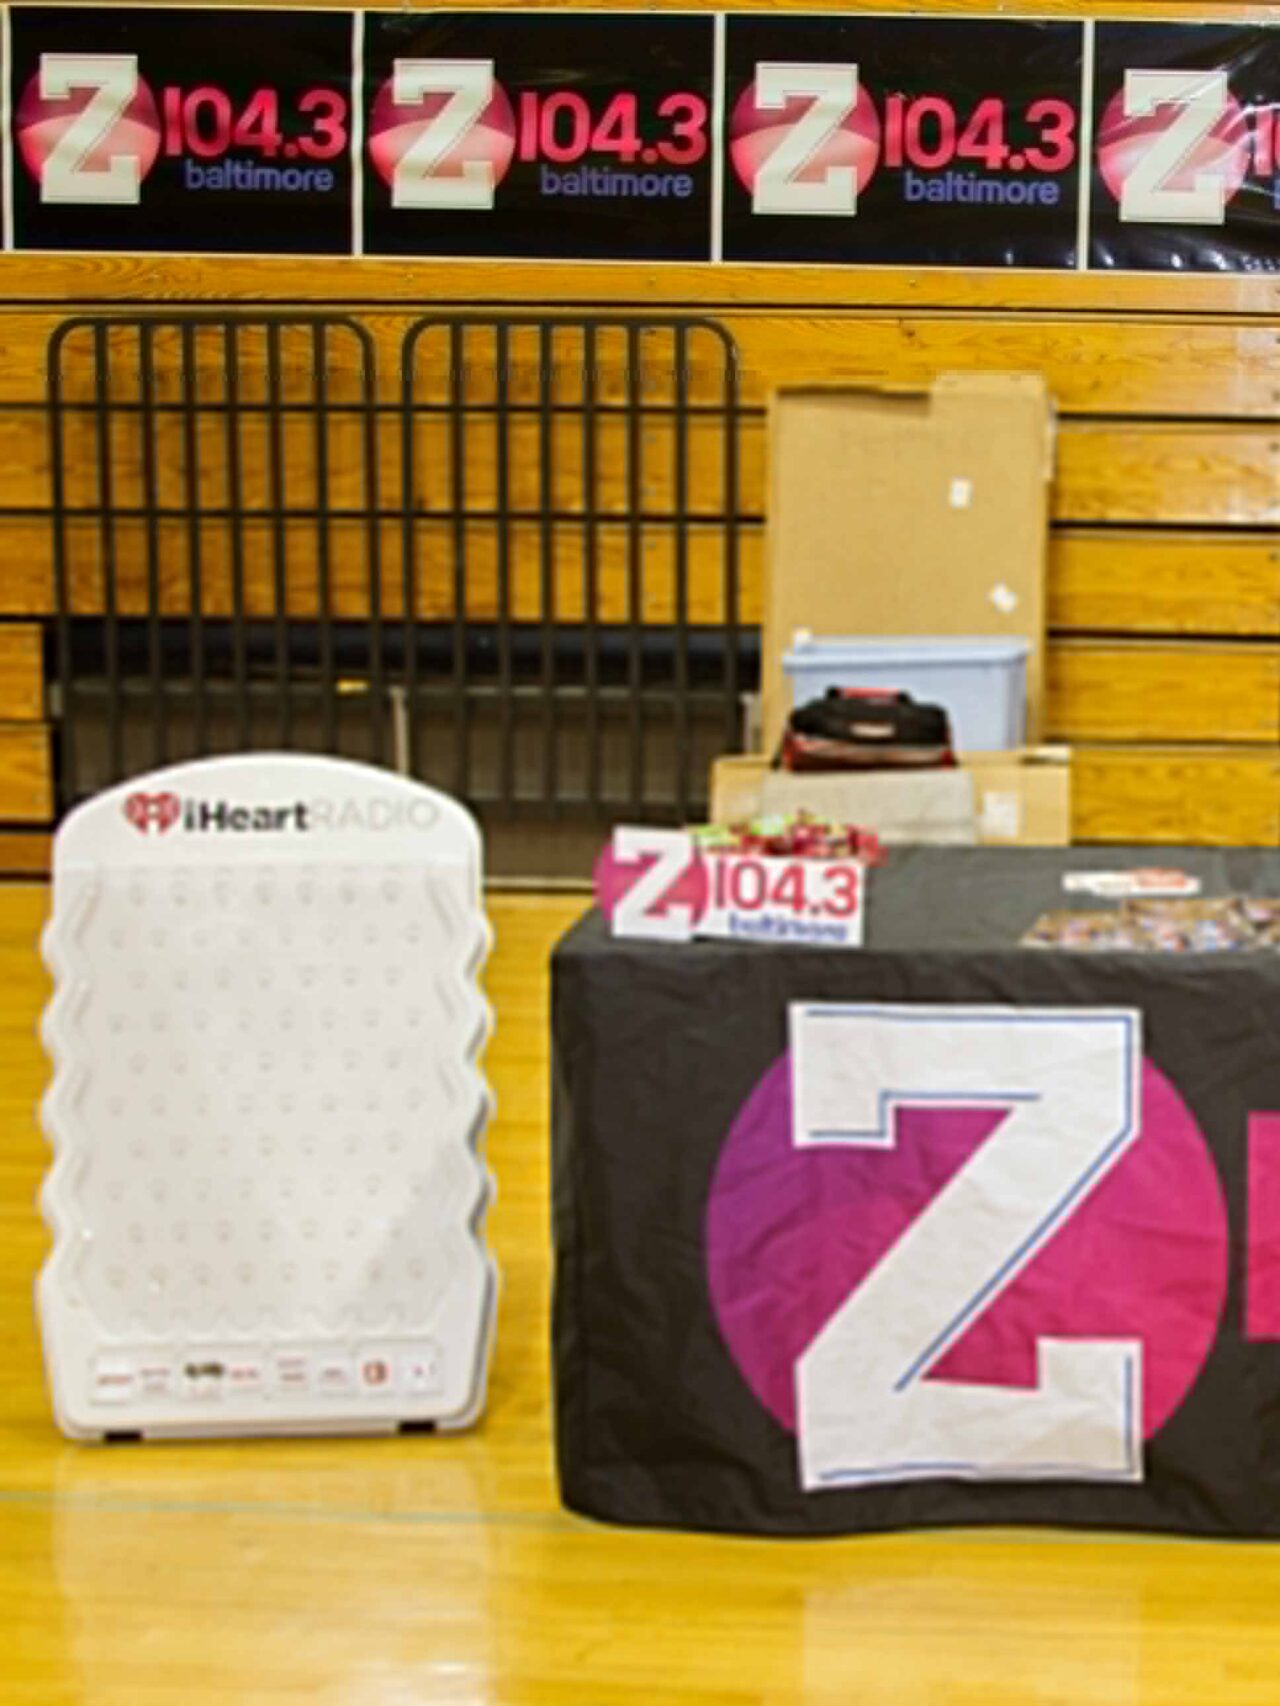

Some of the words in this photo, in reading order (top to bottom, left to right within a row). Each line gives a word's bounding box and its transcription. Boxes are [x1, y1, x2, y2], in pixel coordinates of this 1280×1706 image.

[40, 53, 139, 203] Z
[164, 88, 347, 160] 104.3
[185, 157, 334, 193] baltimore
[391, 58, 494, 209] Z
[520, 93, 707, 165] 104.3
[541, 163, 693, 198] baltimore
[752, 62, 858, 215] Z
[882, 96, 1075, 172] 104.3
[904, 169, 1059, 207] baltimore
[1120, 68, 1228, 224] Z
[612, 825, 694, 943] Z
[714, 859, 858, 917] 104.3
[789, 1002, 1143, 1491] Z
